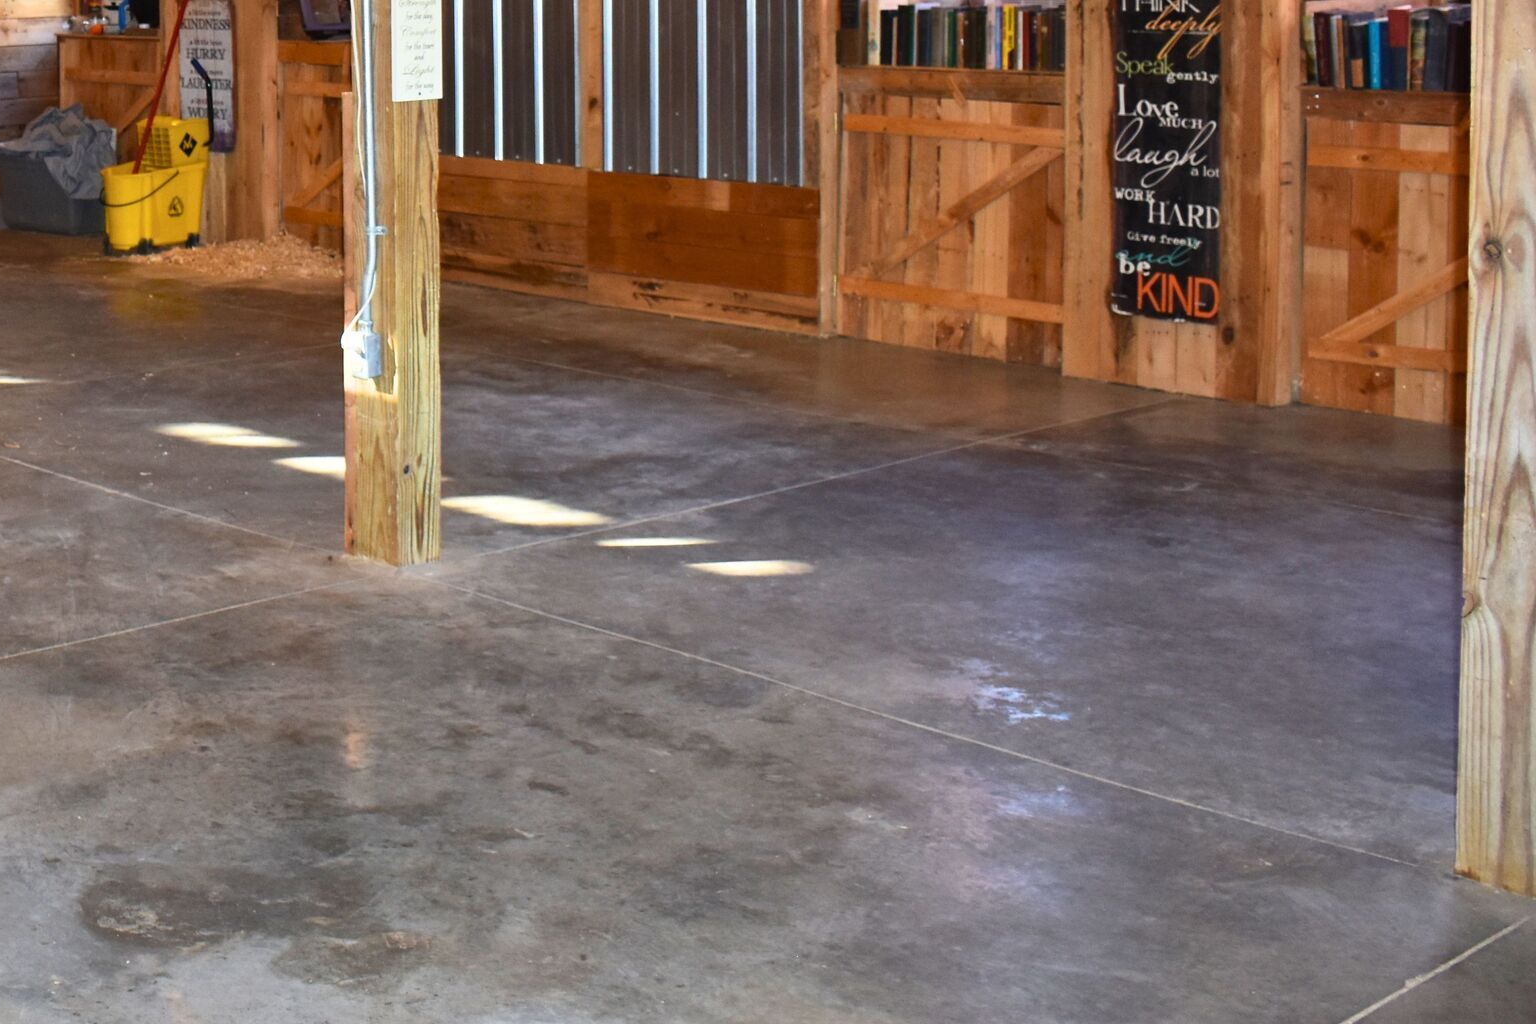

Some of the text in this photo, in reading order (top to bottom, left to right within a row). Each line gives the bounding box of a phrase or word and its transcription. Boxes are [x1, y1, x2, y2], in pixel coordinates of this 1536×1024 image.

[182, 19, 230, 30] KINDNESS
[1145, 0, 1222, 59] deeply
[186, 48, 226, 60] HURRY
[1116, 51, 1174, 78] Speak
[1166, 71, 1218, 84] gently
[1118, 84, 1179, 118] Love
[1160, 117, 1203, 129] MUCH
[1114, 117, 1217, 189] laugh
[1190, 165, 1220, 177] a lot
[1115, 187, 1156, 202] WORK
[1147, 201, 1220, 229] HARD
[1127, 231, 1202, 250] Give freely
[1119, 252, 1151, 276] be
[1136, 272, 1220, 319] KIND
